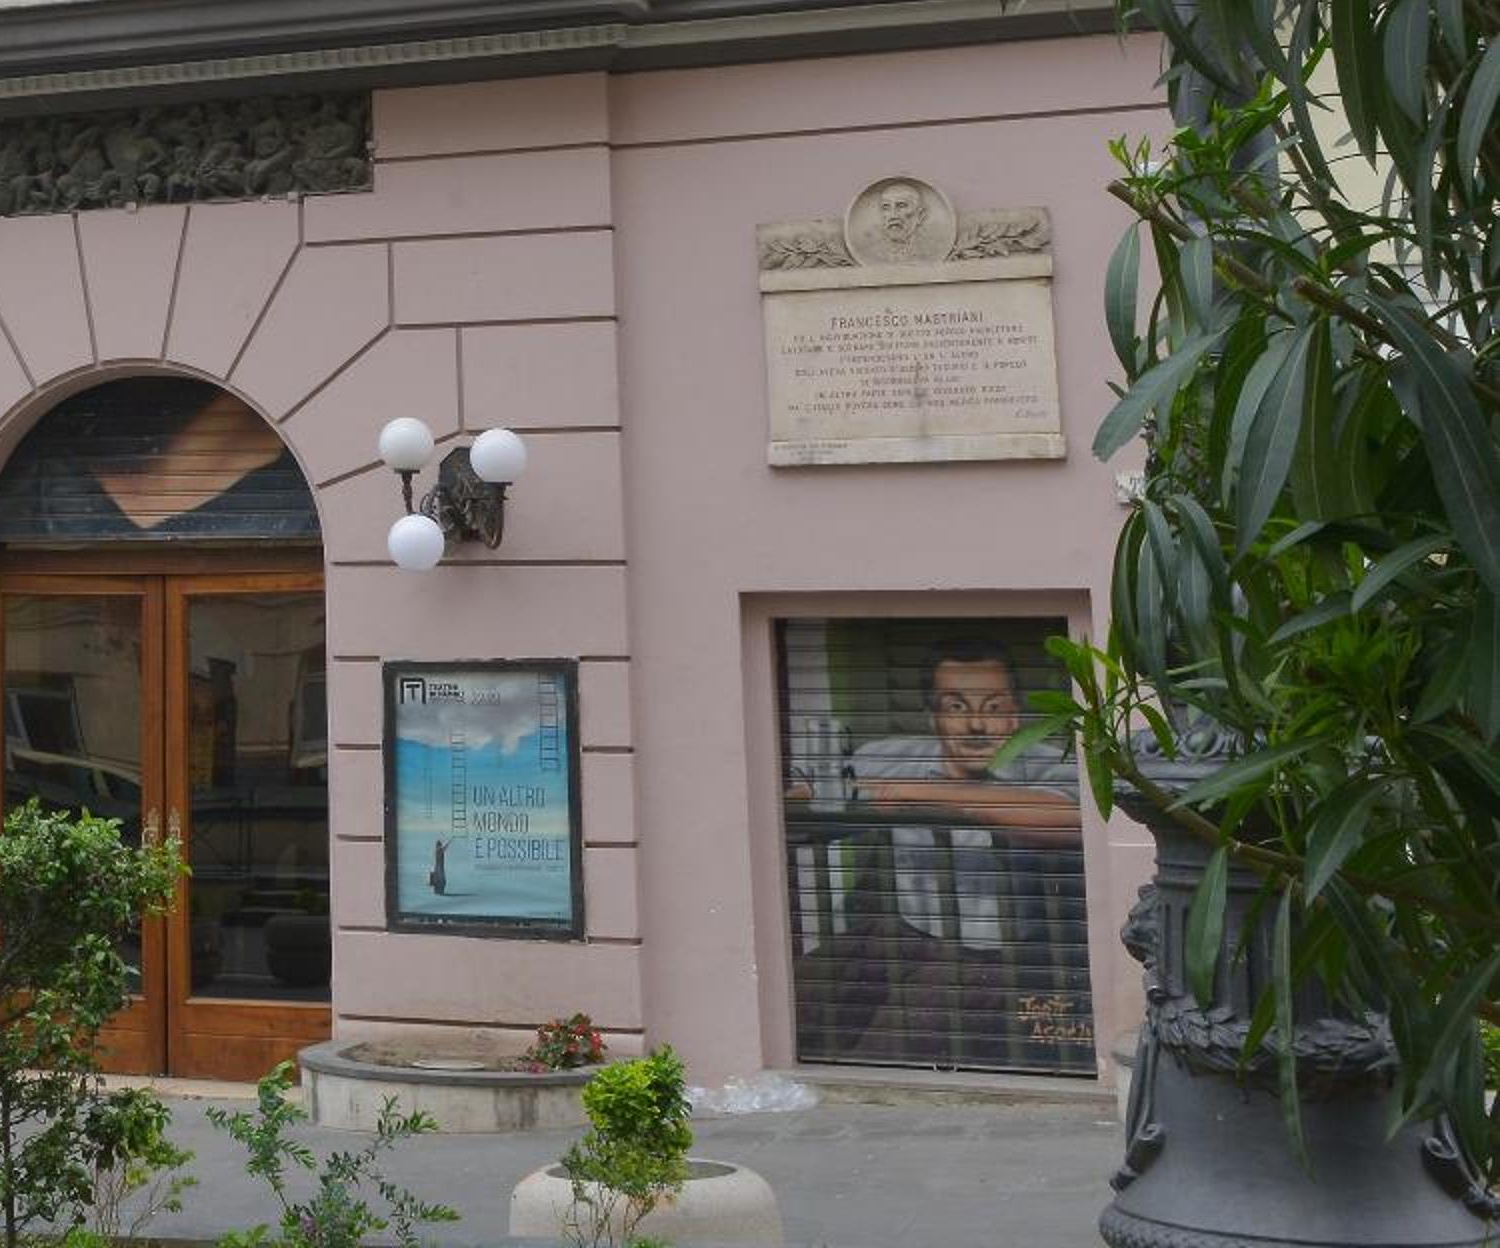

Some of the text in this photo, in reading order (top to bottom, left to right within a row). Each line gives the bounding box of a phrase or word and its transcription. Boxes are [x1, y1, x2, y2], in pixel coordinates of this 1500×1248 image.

[831, 311, 983, 329] FRANCESCO MASTRIANI
[473, 785, 546, 808] UN ALTRO
[474, 812, 529, 833] MONDO
[487, 838, 565, 861] POSSIBILE
